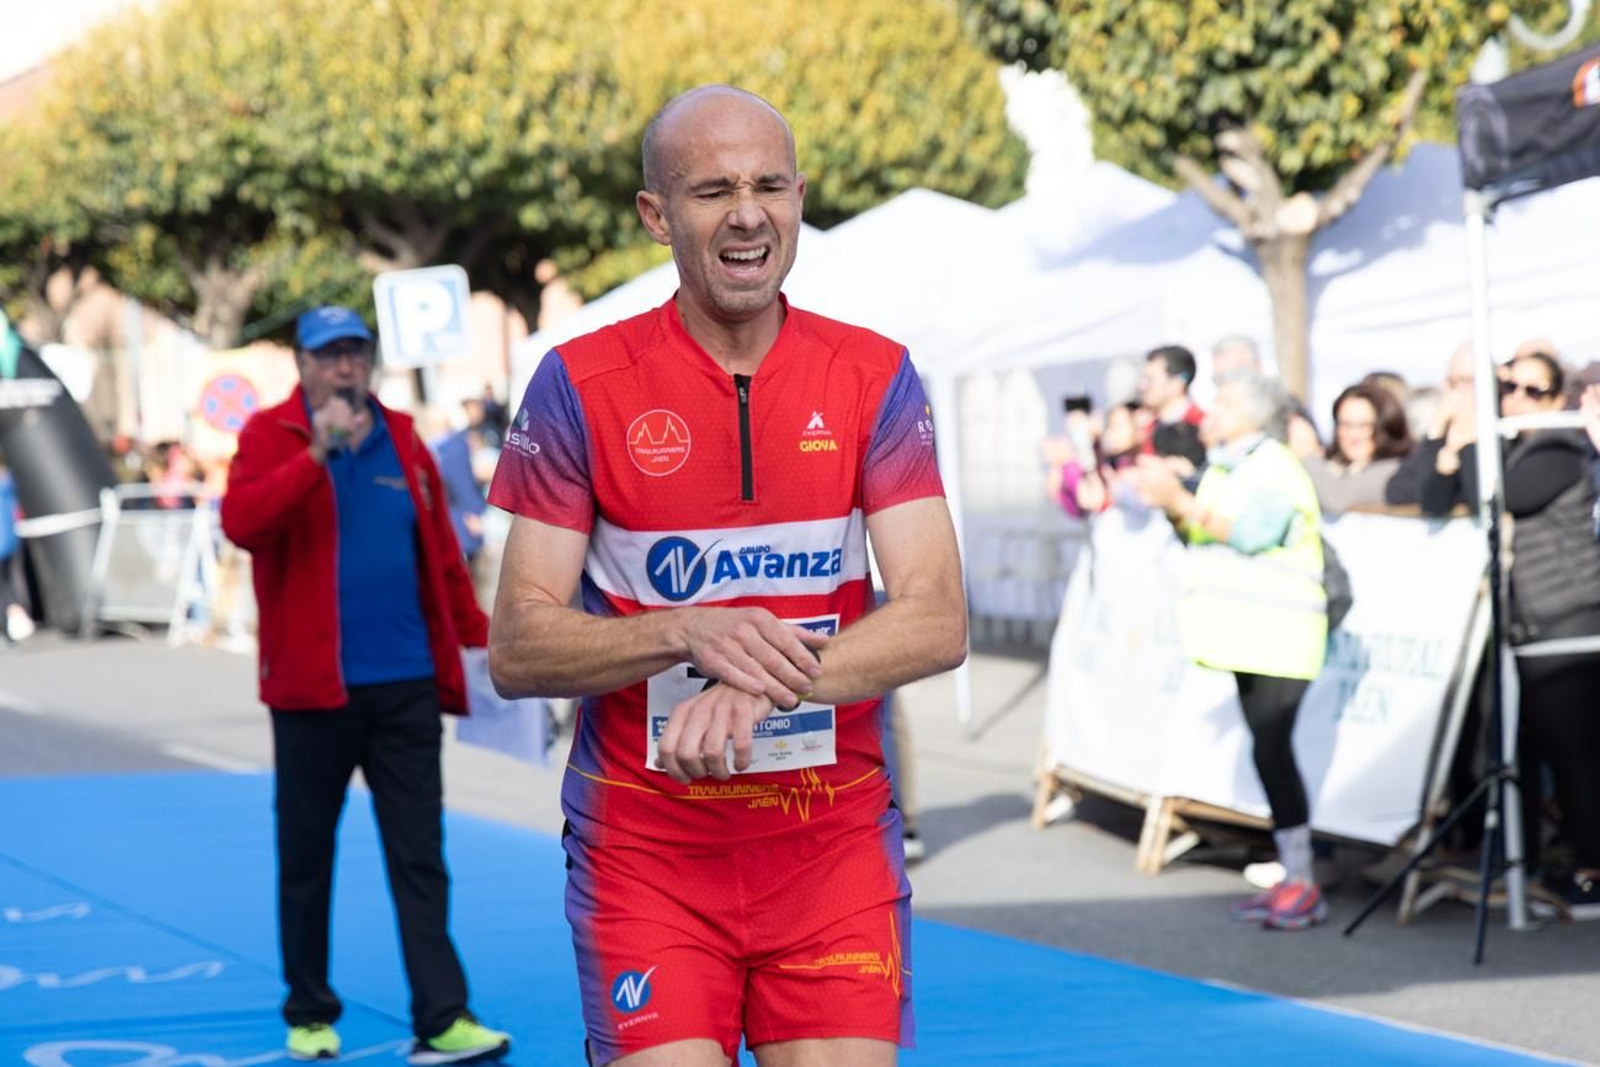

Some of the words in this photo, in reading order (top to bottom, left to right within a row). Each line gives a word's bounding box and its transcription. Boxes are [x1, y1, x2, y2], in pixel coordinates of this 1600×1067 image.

[393, 281, 453, 357] P
[799, 440, 838, 452] GIOVA
[740, 545, 770, 555] GRUPO
[711, 548, 842, 584] Avanza
